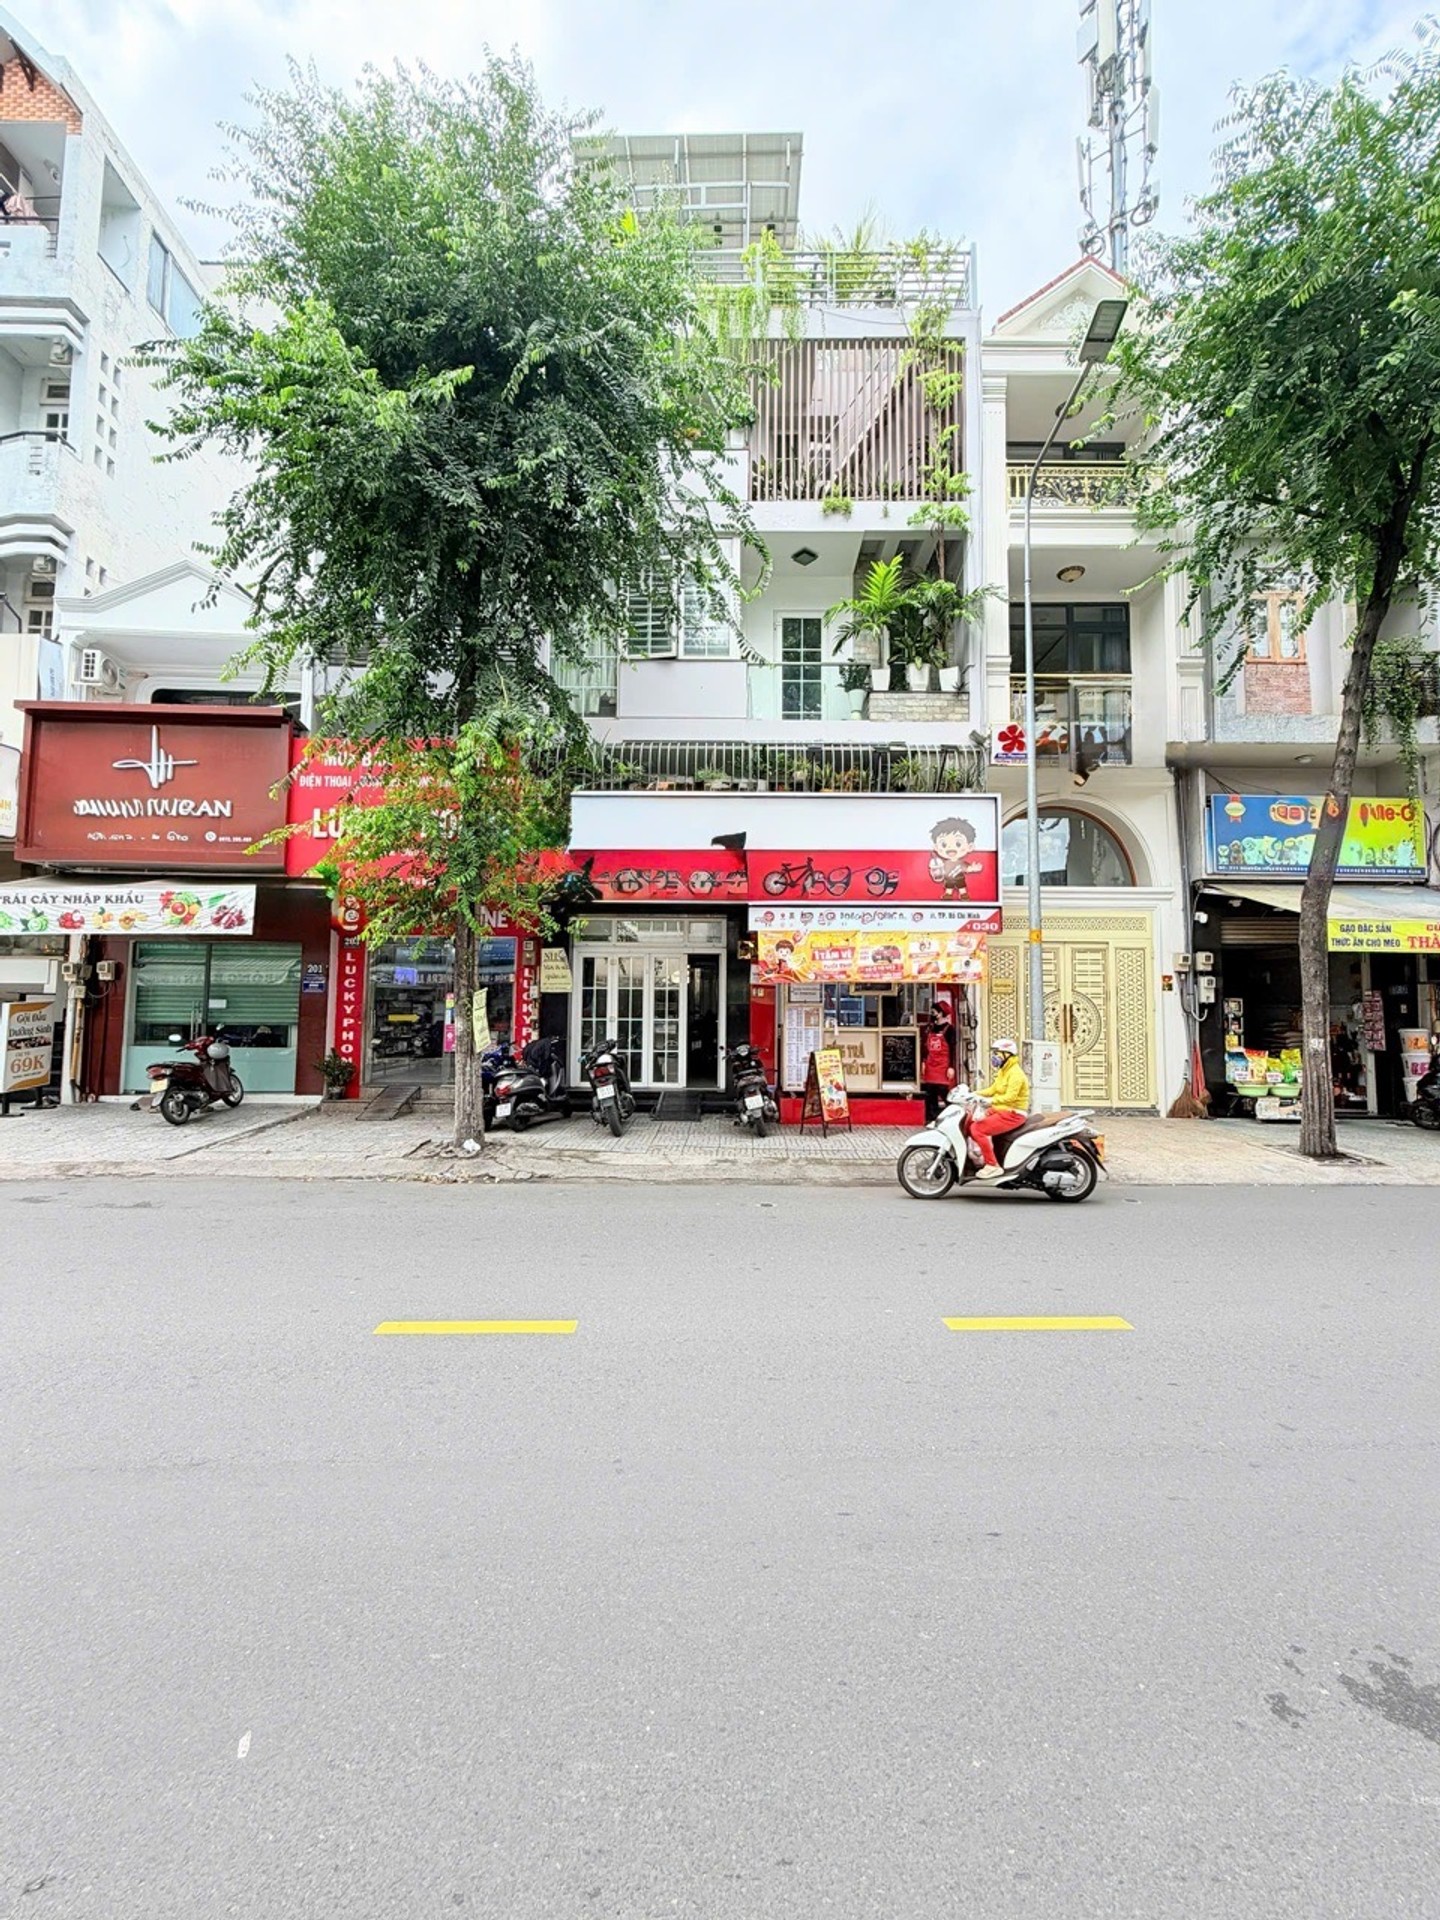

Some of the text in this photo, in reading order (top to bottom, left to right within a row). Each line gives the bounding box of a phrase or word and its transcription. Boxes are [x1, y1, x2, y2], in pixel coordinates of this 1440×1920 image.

[299, 773, 322, 789] ĐIỆN
[324, 775, 352, 789] THOẠI
[31, 892, 59, 904] CÂY
[63, 894, 101, 906] NHẬP
[105, 890, 144, 904] KHẨU
[1339, 924, 1356, 935] GẠO
[307, 964, 323, 973] 201
[10, 1055, 45, 1074] 69K
